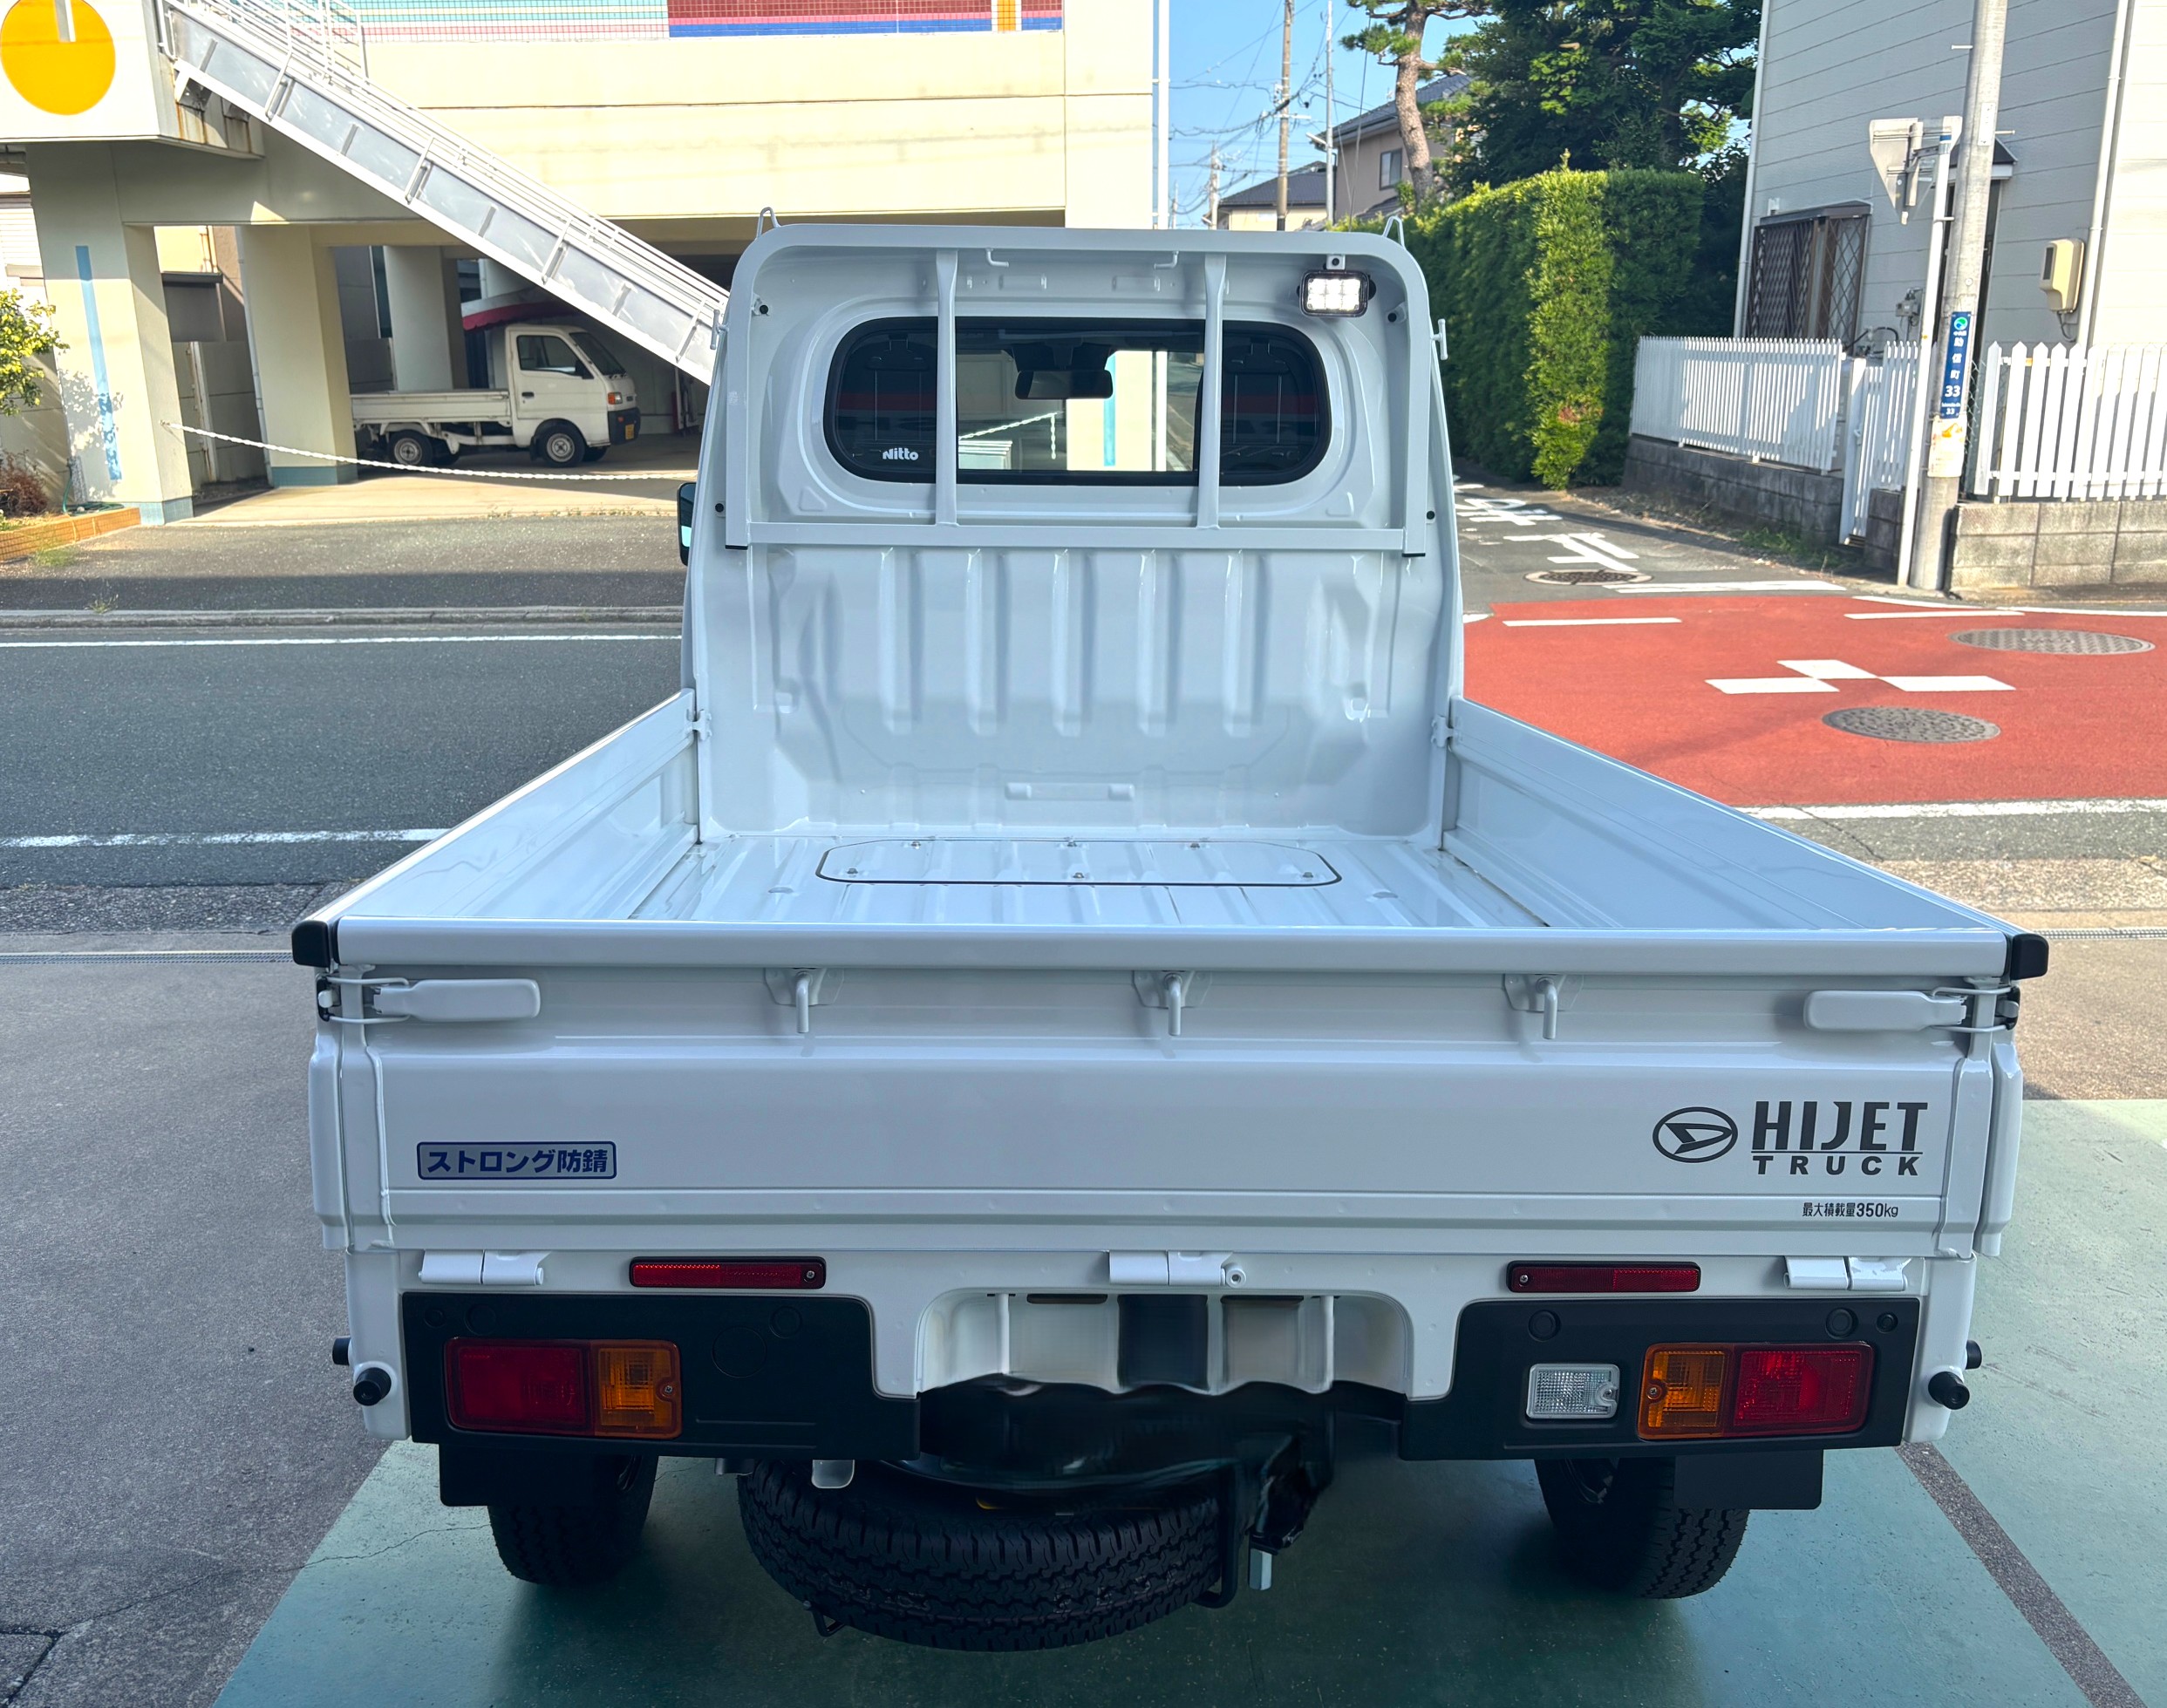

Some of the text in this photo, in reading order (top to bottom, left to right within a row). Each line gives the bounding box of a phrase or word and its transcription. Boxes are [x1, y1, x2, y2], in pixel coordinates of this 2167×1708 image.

[1945, 384, 1961, 398] 33
[882, 446, 919, 461] Nitto
[1454, 475, 1639, 572] 止ま
[1751, 1100, 1928, 1151] HIJET
[426, 1148, 609, 1174] ストロング防錆
[1753, 1155, 1920, 1176] TRUCK
[1802, 1202, 1899, 1218] 最大積載量350kg
